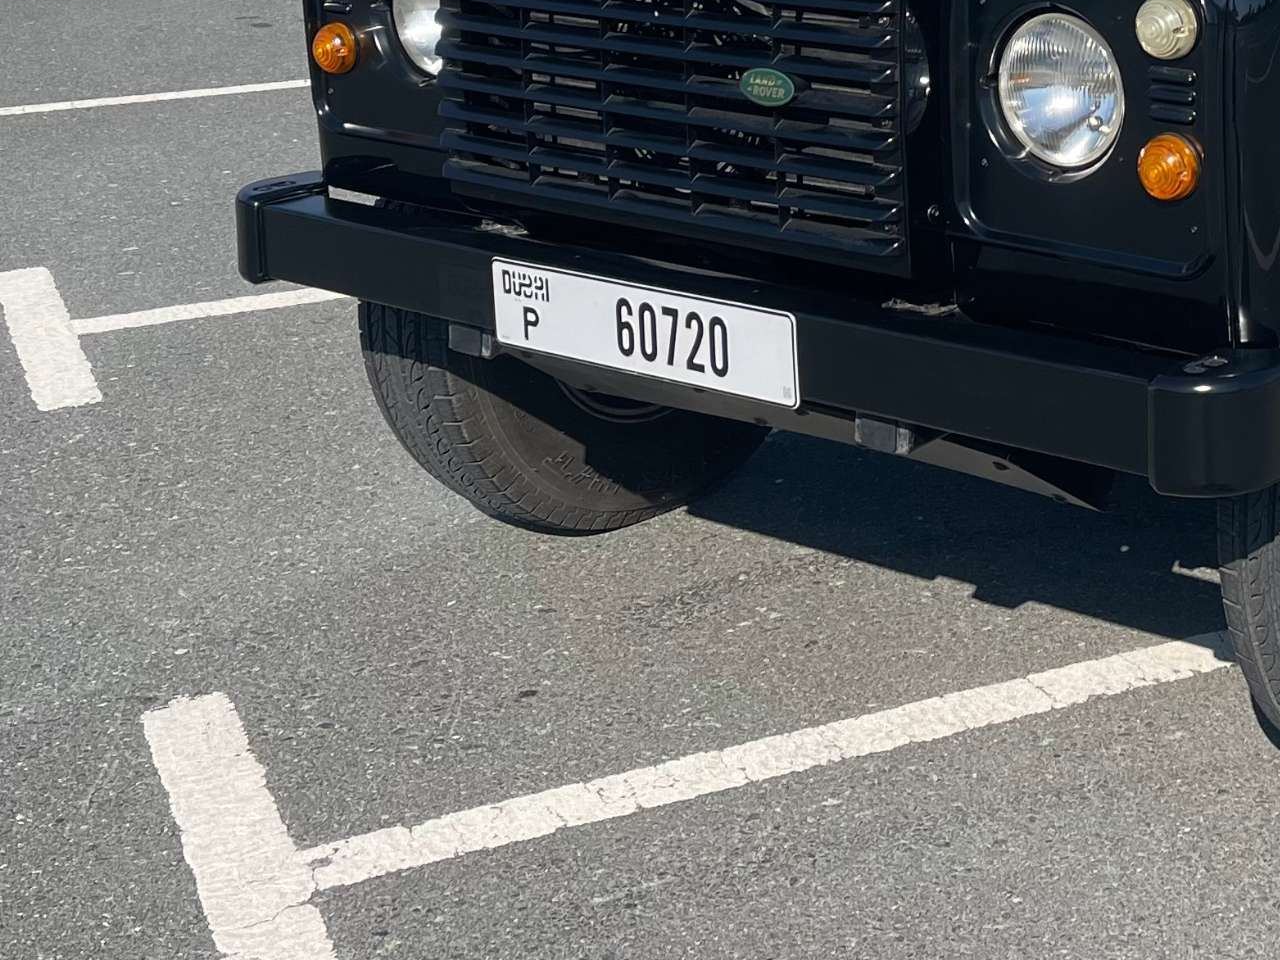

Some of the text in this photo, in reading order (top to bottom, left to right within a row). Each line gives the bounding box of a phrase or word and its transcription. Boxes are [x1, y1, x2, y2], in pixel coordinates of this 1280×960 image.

[752, 85, 785, 99] ROVER
[523, 306, 540, 341] P
[615, 297, 729, 378] 60720
